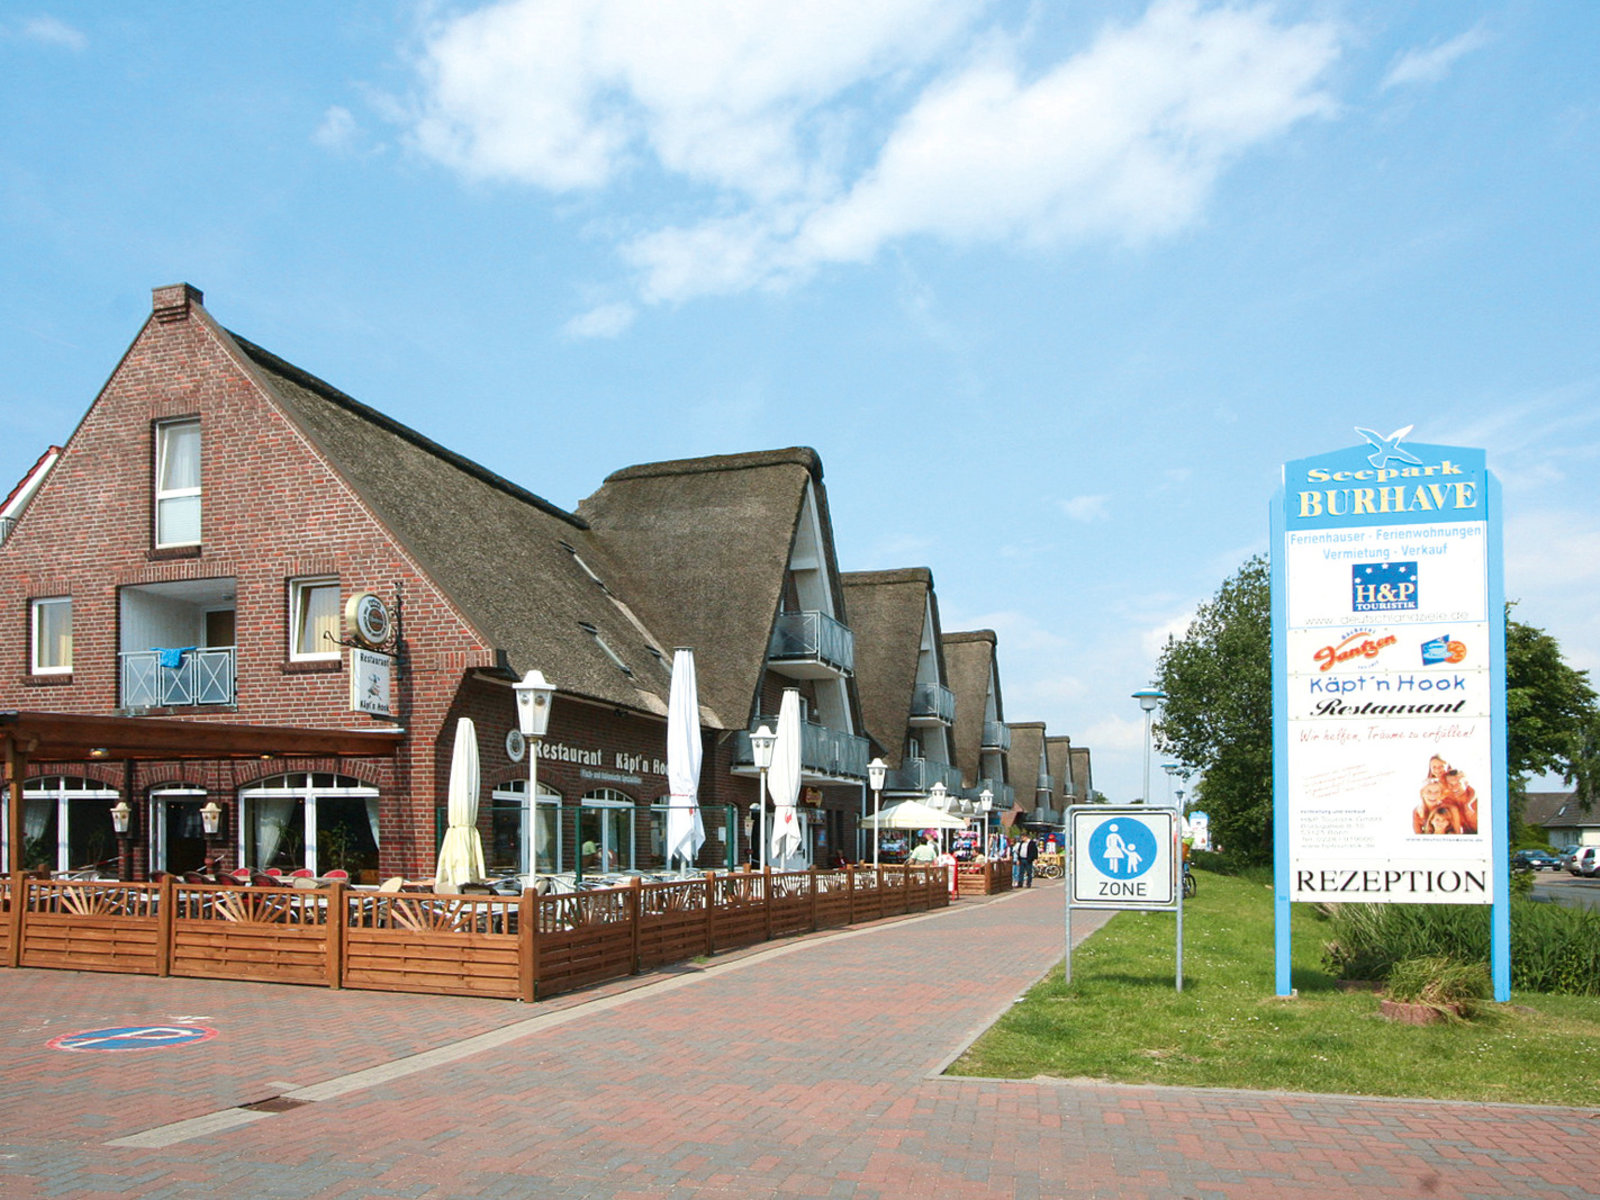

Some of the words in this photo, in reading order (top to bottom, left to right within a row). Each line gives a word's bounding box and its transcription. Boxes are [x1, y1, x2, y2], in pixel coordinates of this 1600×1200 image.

[1307, 461, 1463, 482] Seepark
[1297, 482, 1477, 518] BURHAVE
[1376, 526, 1481, 541] Ferienwohnungen
[1323, 546, 1390, 560] Vermietung
[1401, 543, 1448, 556] Verkauf
[1355, 582, 1416, 603] H&P
[1356, 602, 1416, 611] TOURISTIK
[1397, 675, 1466, 692] Hook
[1310, 698, 1466, 716] Restaurant
[537, 740, 602, 766] Restaurant
[1099, 882, 1147, 896] ZONE
[1297, 870, 1486, 892] REZEPTION
